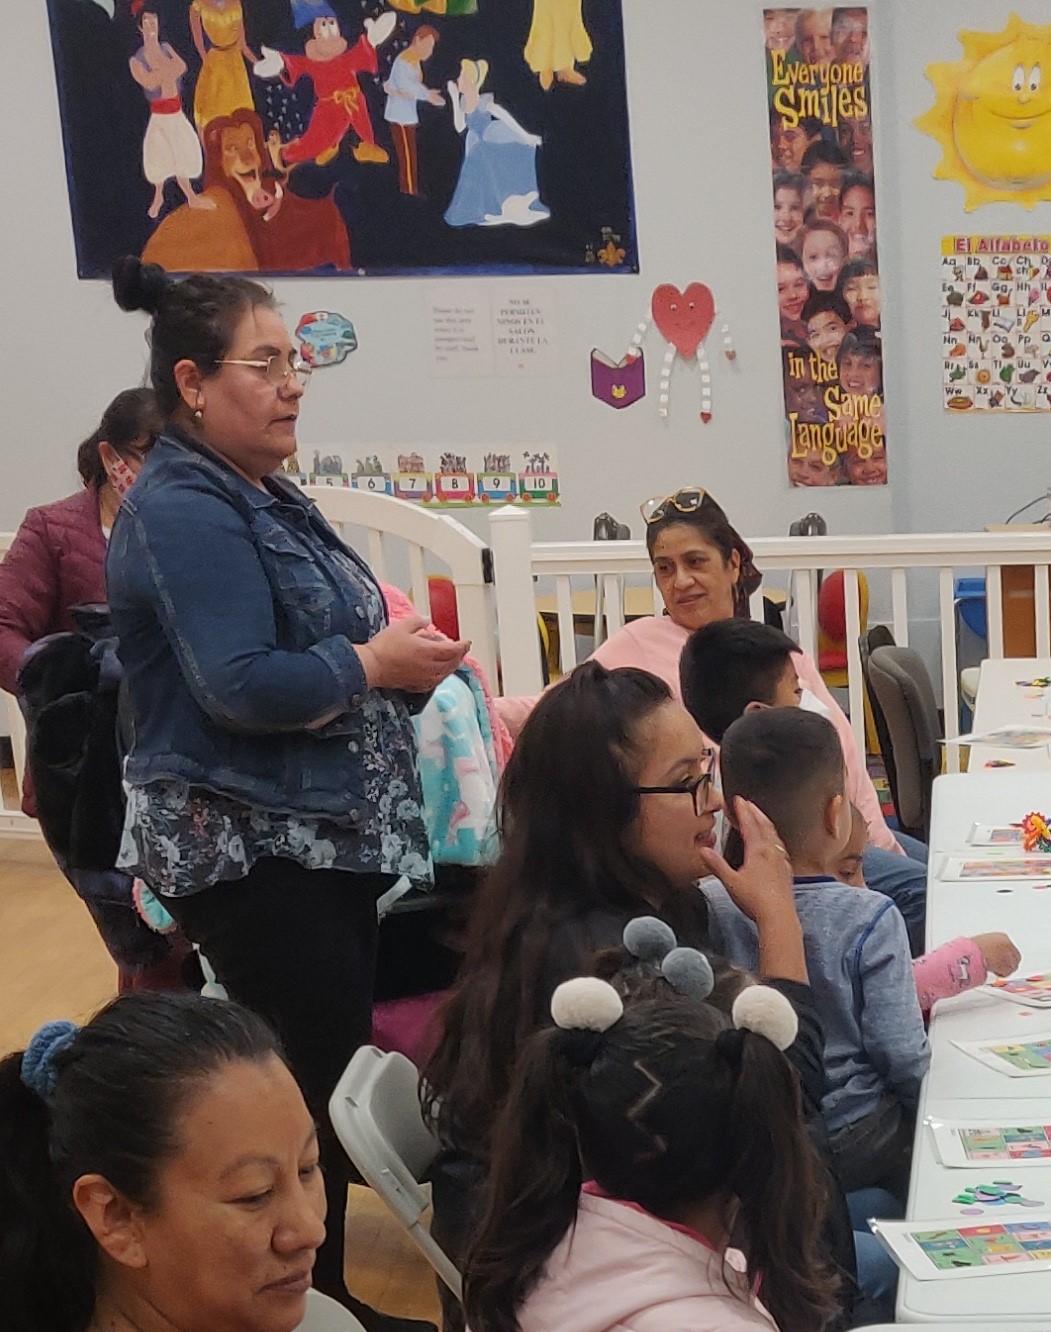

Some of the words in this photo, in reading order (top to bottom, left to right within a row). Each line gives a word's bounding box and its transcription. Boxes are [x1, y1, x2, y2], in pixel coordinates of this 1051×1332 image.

[770, 48, 864, 95] Everyone
[773, 84, 868, 131] Smiles
[955, 238, 972, 251] El
[976, 238, 1050, 252] Alfabeto
[787, 352, 806, 379] in
[809, 348, 839, 383] the
[823, 384, 882, 422] Same
[788, 411, 884, 465] Language
[366, 477, 376, 490] 6
[408, 477, 417, 489] 7
[451, 478, 460, 490] 8
[492, 477, 501, 489] 9
[532, 478, 546, 489] 10
